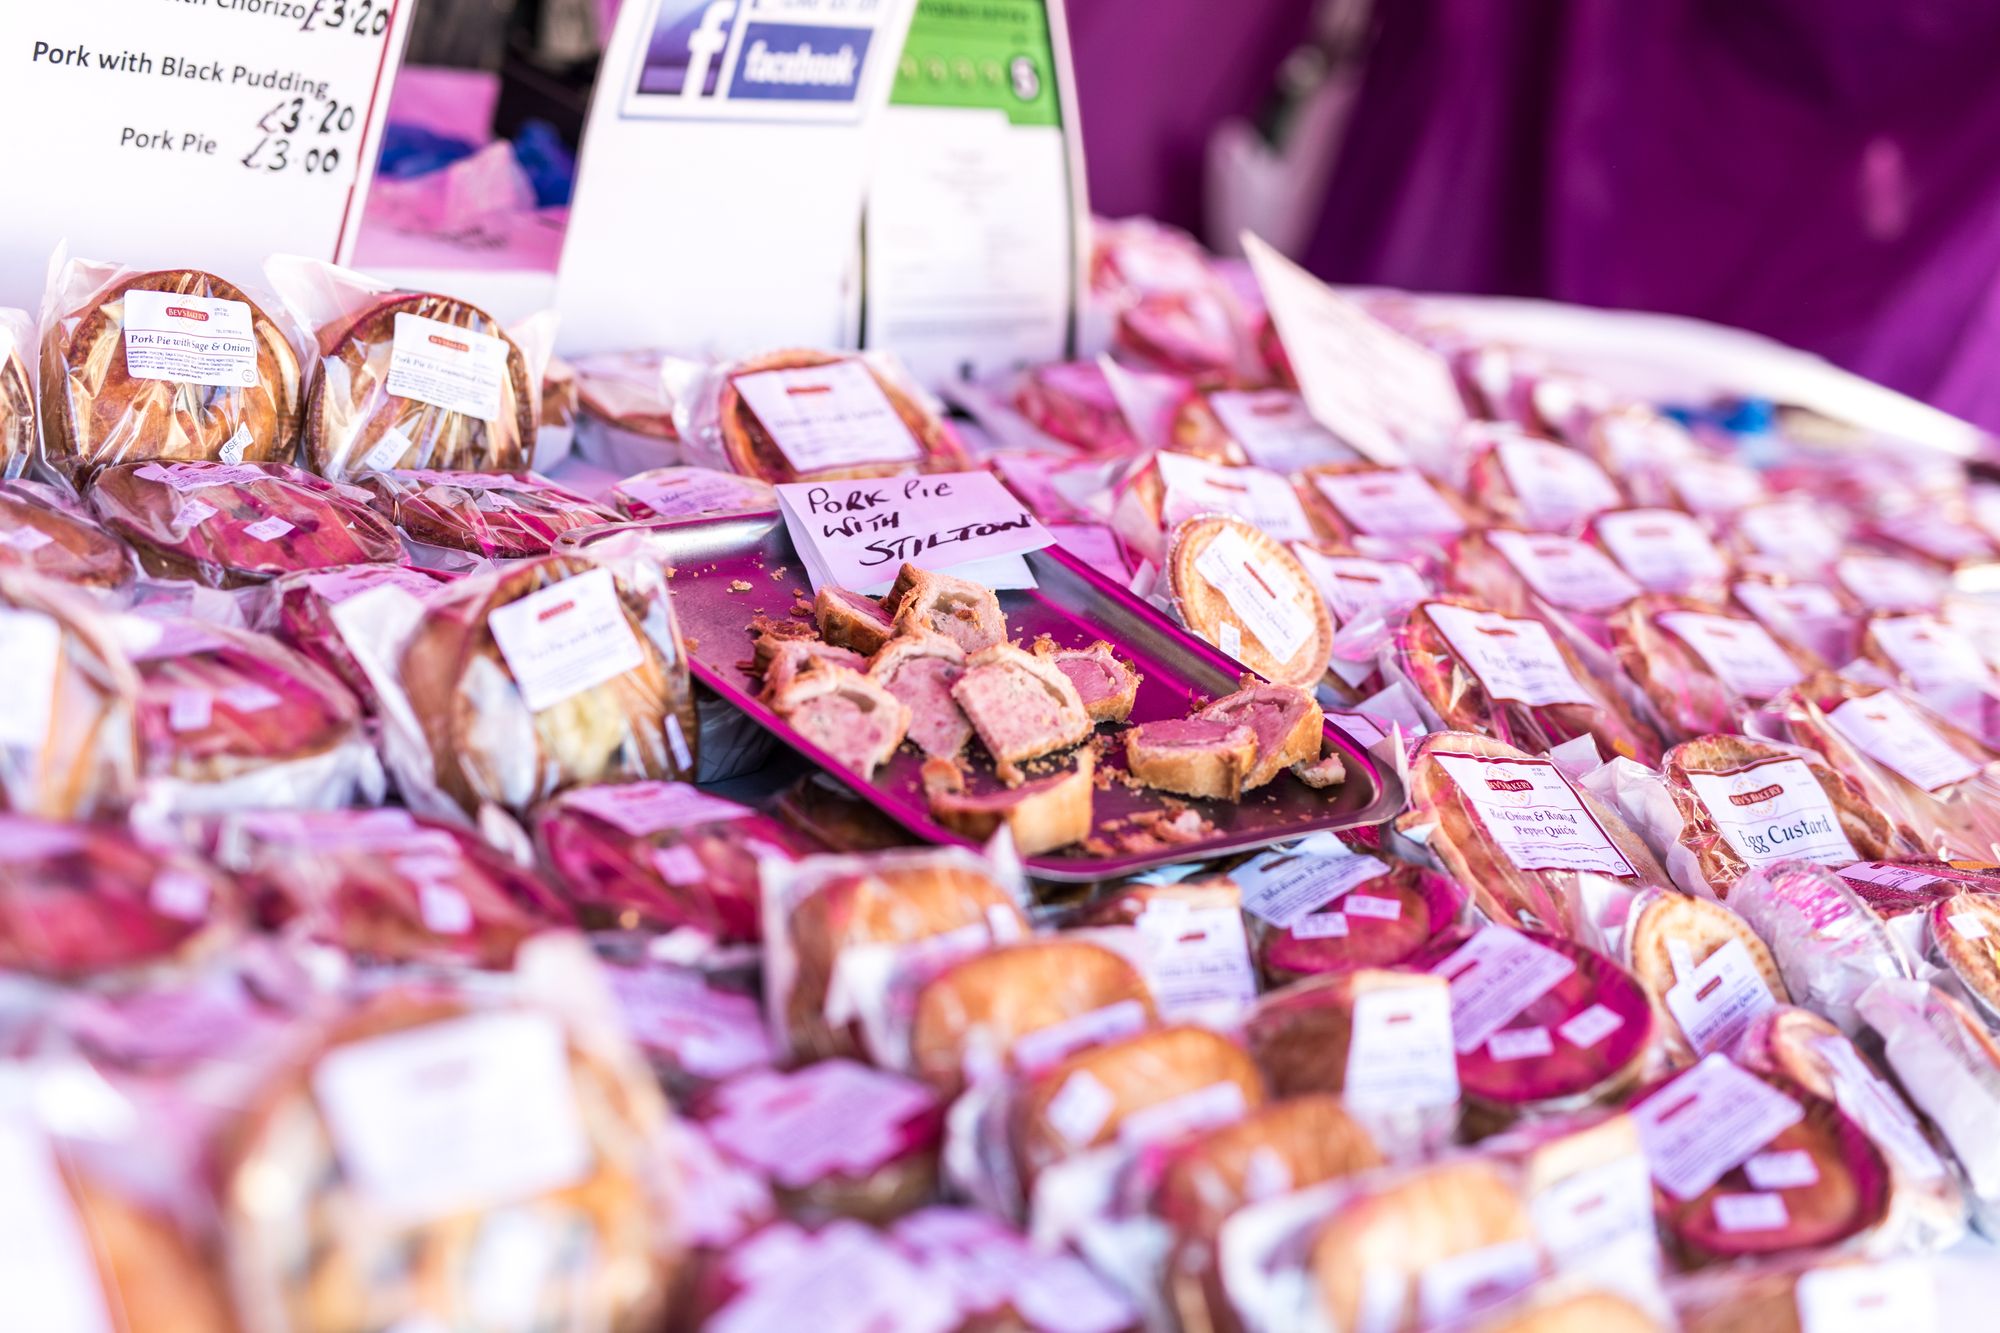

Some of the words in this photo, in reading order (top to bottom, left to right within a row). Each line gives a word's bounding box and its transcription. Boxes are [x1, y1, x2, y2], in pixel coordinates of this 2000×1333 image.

[32, 41, 90, 67] Pork
[99, 51, 152, 74] with
[161, 56, 224, 82] Black
[232, 66, 330, 100] Pudding
[743, 39, 859, 86] facebook
[120, 127, 172, 151] Pork
[182, 133, 217, 156] Pie
[130, 334, 155, 345] Pork
[156, 335, 171, 346] Pie
[173, 336, 191, 348] with
[191, 339, 208, 352] Sage
[211, 342, 221, 351] &
[222, 342, 251, 353] Onion
[807, 487, 891, 515] PORK
[858, 513, 1032, 566] STILTON
[1504, 811, 1534, 822] Onion
[1534, 811, 1544, 822] &
[1738, 829, 1770, 854] Egg
[1767, 814, 1832, 844] Custard
